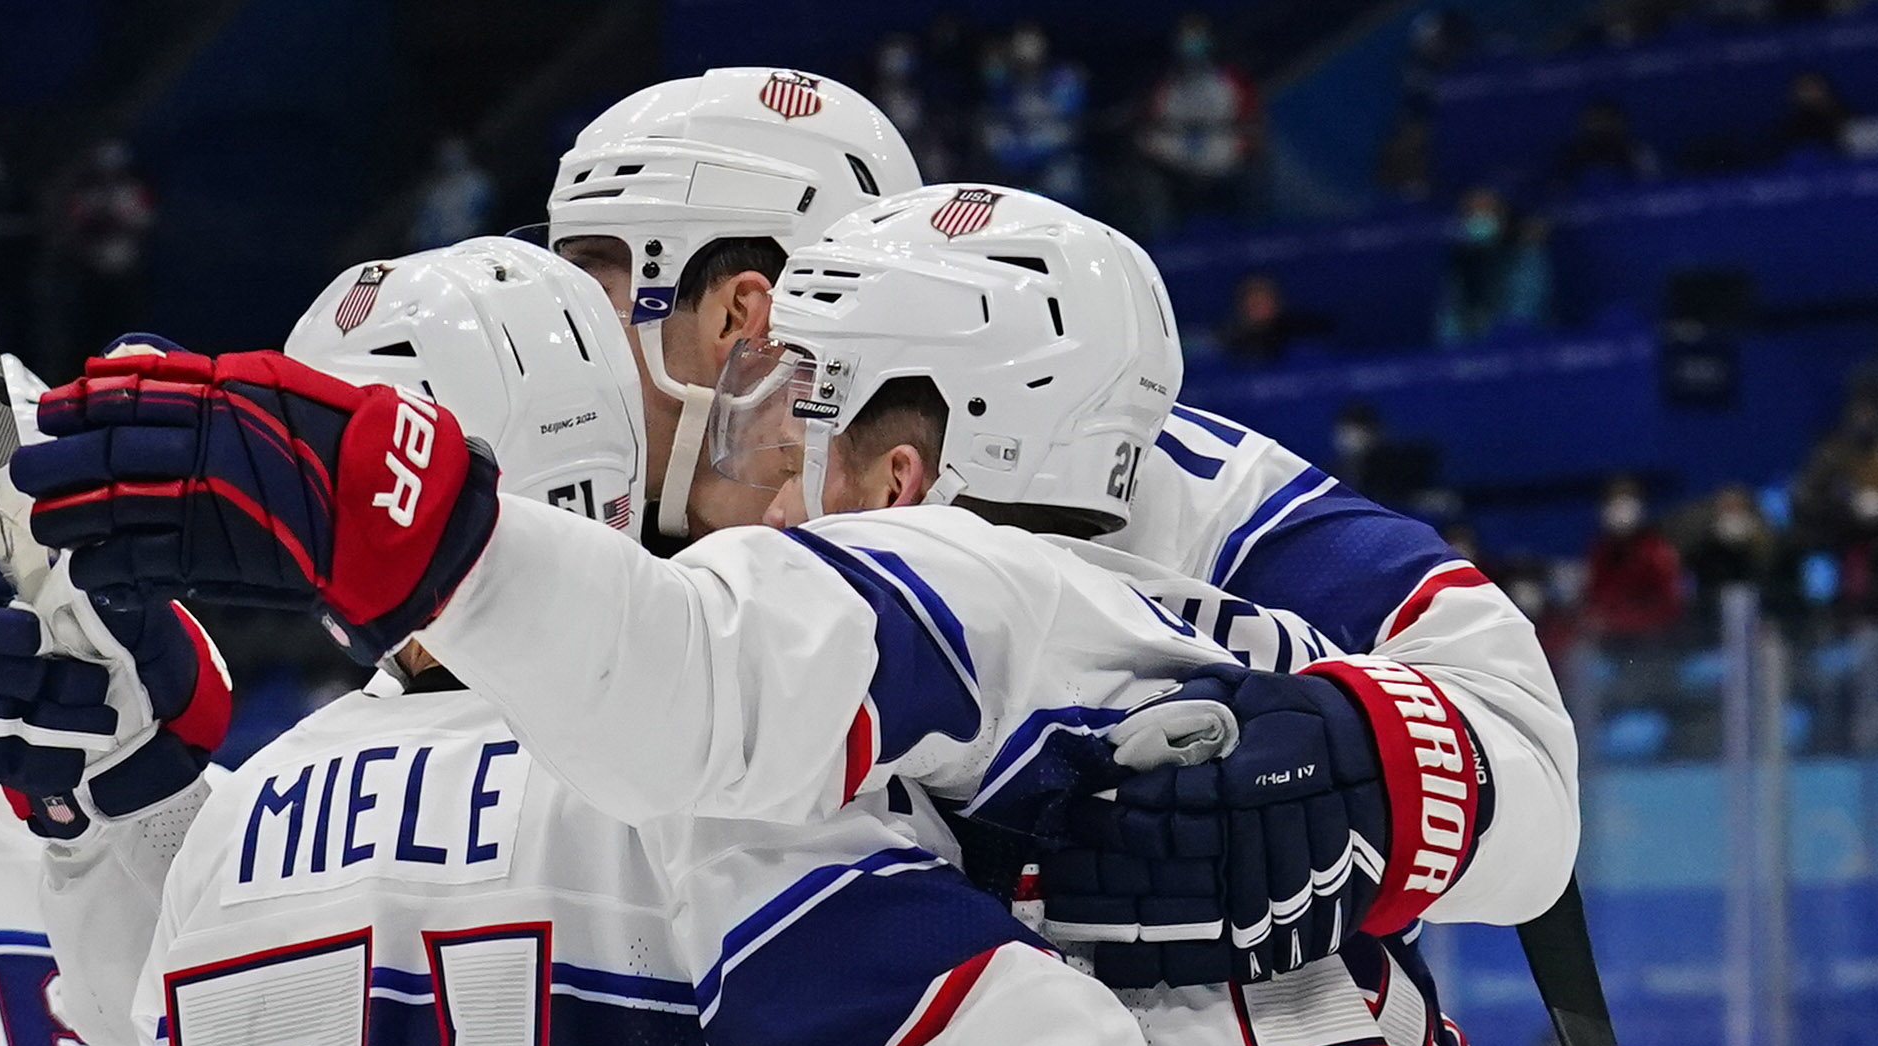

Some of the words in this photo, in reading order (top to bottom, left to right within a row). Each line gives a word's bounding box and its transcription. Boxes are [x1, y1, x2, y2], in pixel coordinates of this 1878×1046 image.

[959, 191, 993, 204] USA
[794, 400, 839, 415] BAUER
[540, 415, 574, 434] BEIJING
[238, 740, 520, 883] MIELE
